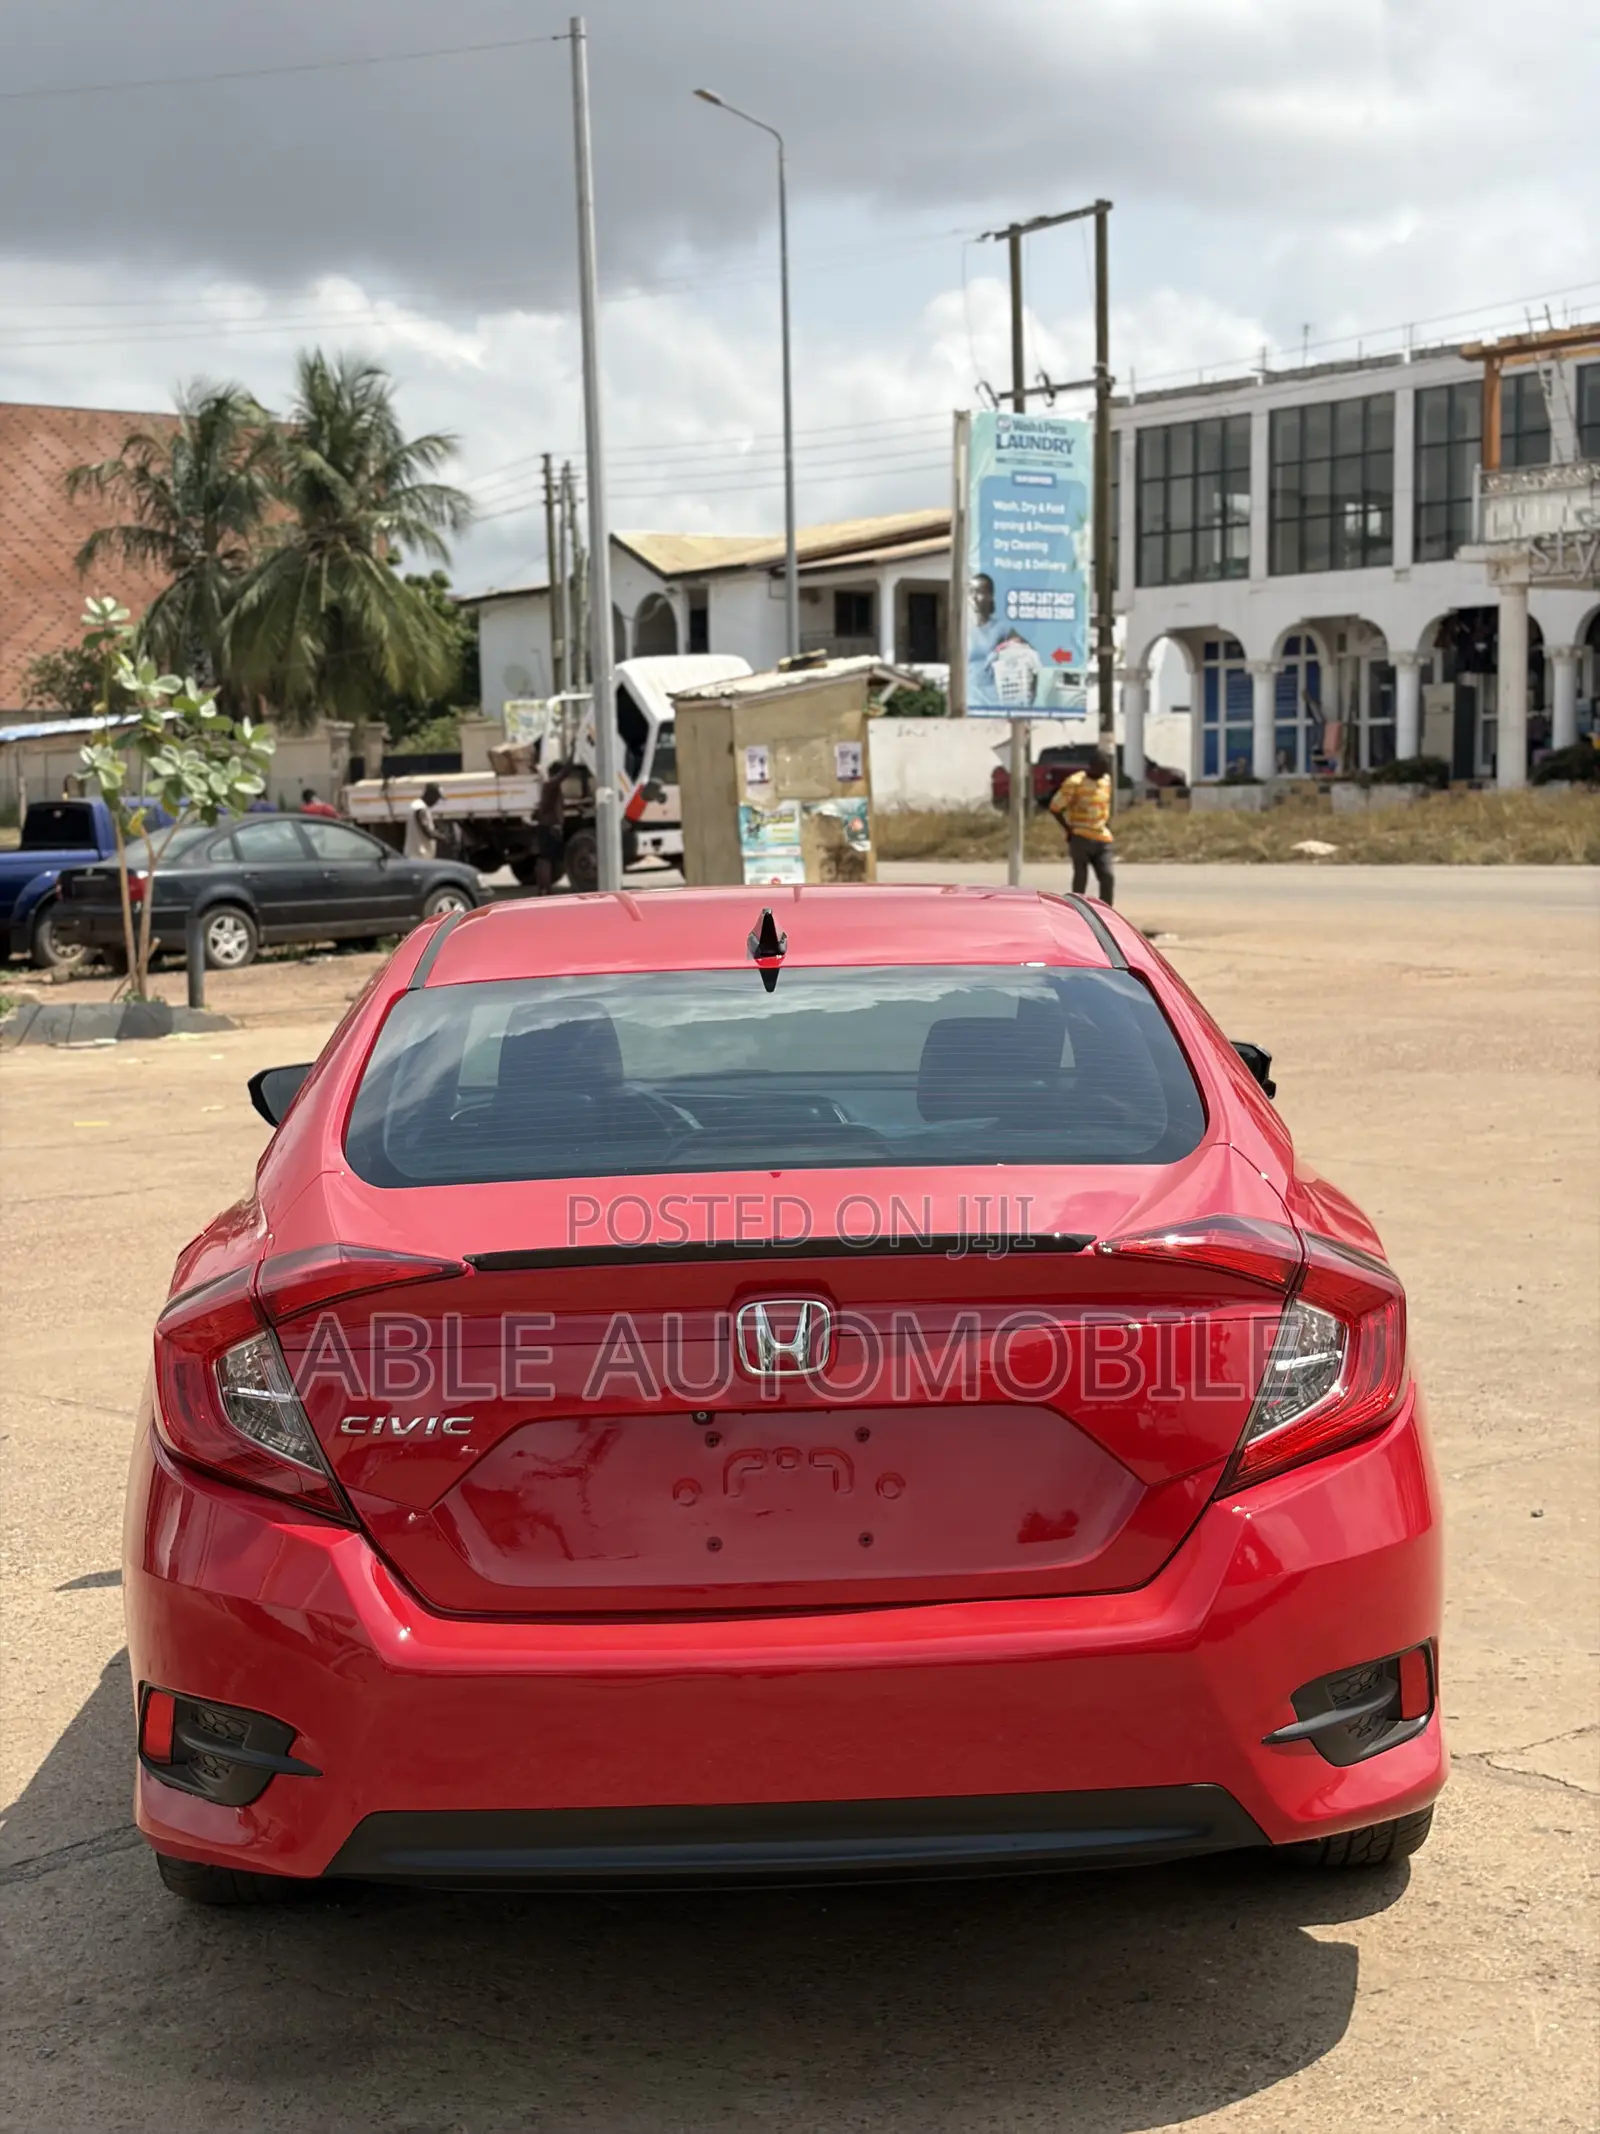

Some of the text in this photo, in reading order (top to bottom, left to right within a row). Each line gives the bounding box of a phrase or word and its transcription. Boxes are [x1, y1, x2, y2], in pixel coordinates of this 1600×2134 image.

[996, 433, 1076, 455] LAUNDRY
[1022, 500, 1037, 516] Dry
[994, 538, 1049, 555] Dry Cleaning
[1033, 558, 1068, 574] Delivery
[340, 1415, 474, 1436] CIVIC
